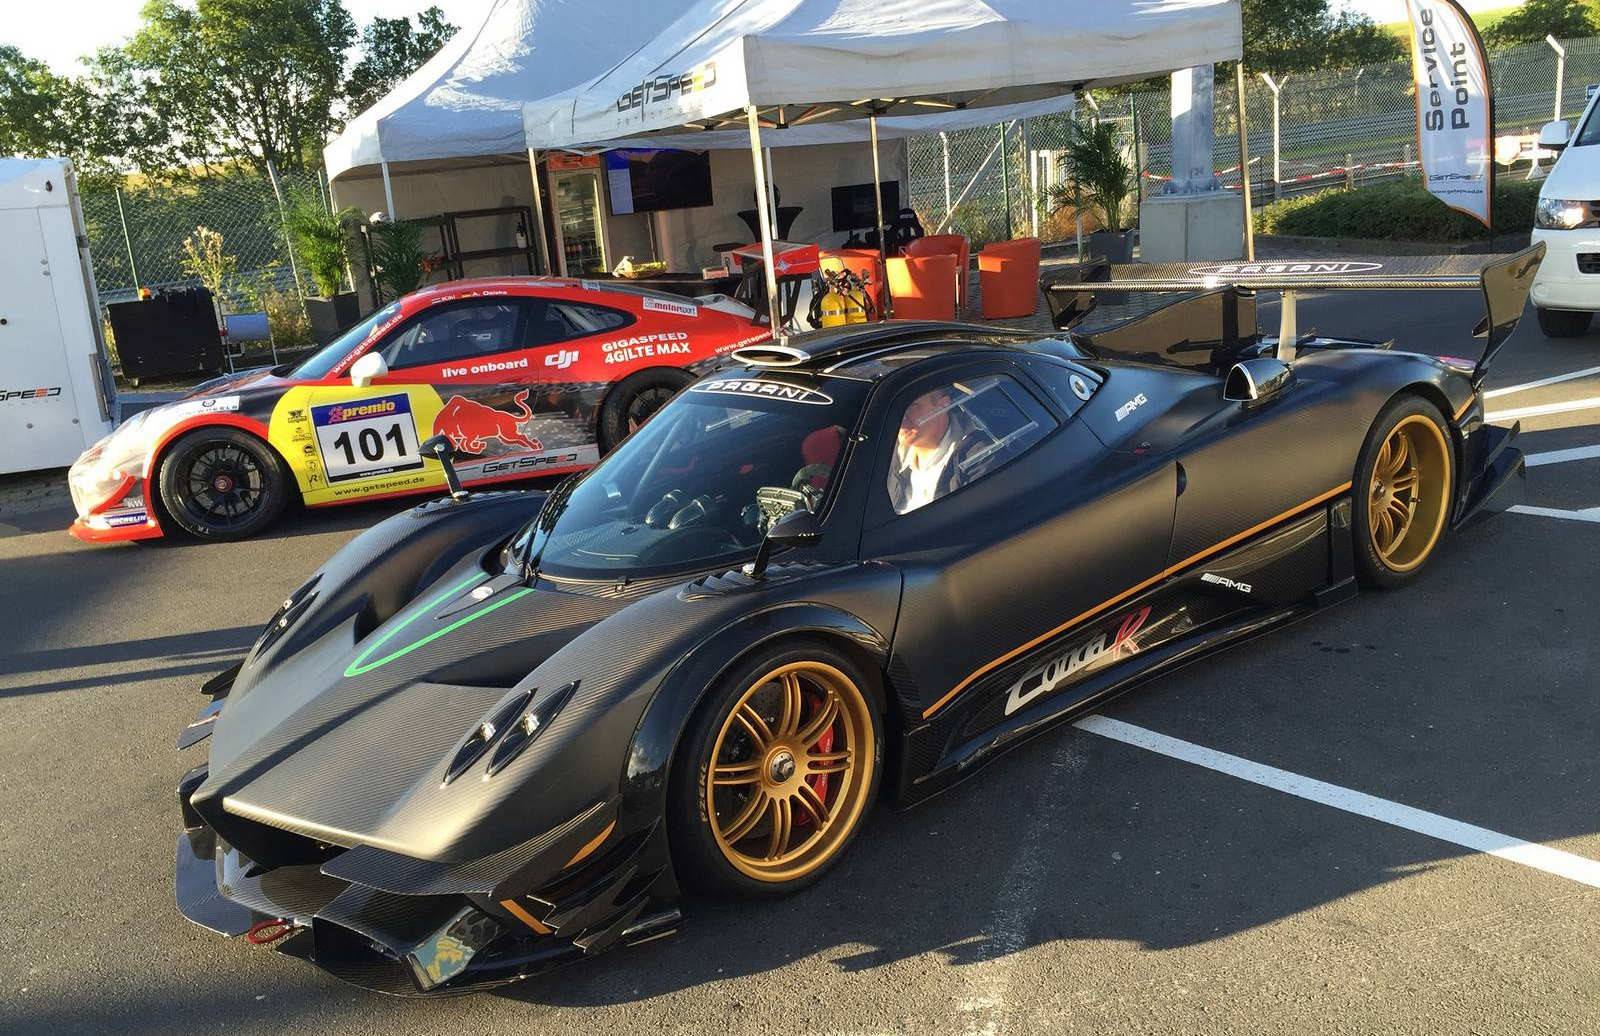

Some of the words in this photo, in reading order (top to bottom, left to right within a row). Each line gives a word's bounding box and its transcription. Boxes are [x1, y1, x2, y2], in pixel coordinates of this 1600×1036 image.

[1420, 8, 1443, 131] Service
[1451, 42, 1469, 130] Point
[1218, 263, 1351, 273] PAGANI
[602, 332, 689, 353] GIGASPEED
[657, 342, 691, 355] MAX
[442, 366, 466, 378] live
[471, 358, 528, 374] onboard
[707, 381, 813, 401] PAGANI
[341, 400, 395, 420] premio
[334, 423, 407, 465] 101
[334, 477, 425, 496] www.getspeed.de
